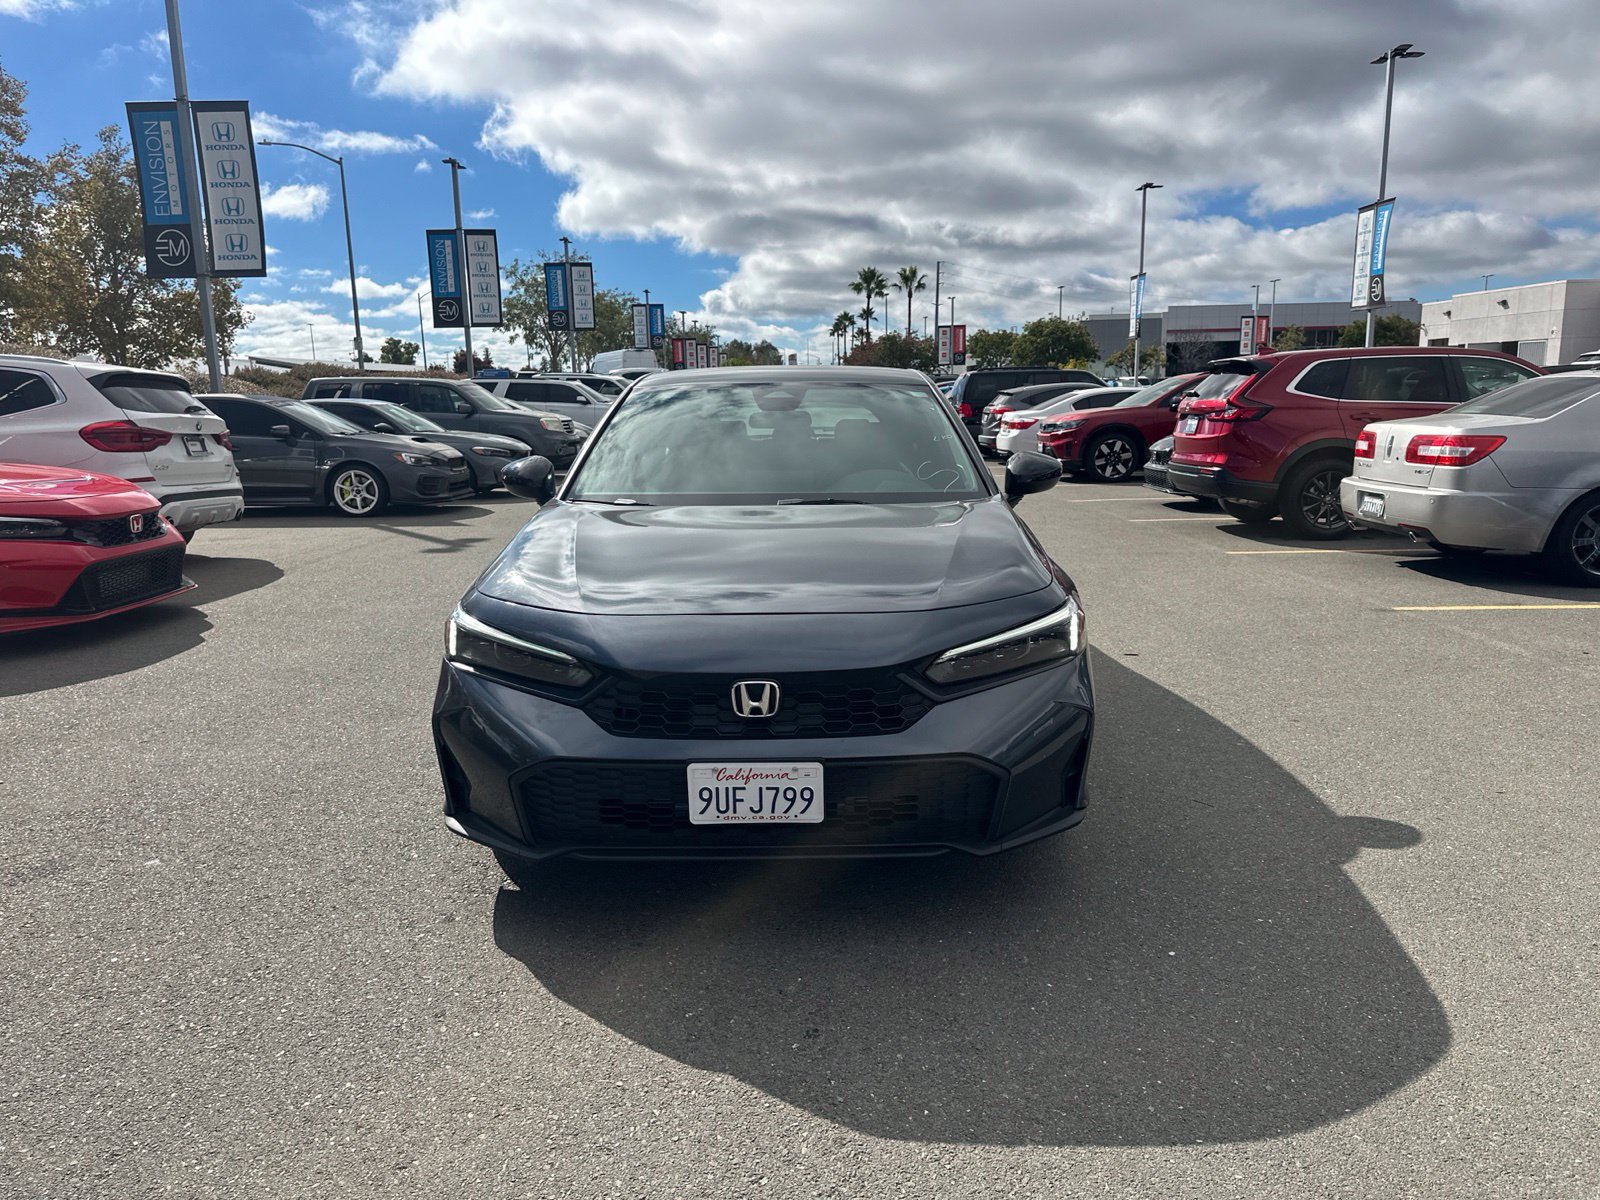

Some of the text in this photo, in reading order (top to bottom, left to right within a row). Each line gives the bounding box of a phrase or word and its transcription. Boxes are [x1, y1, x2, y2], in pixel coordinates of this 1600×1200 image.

[143, 121, 171, 216] ENVISION
[163, 129, 180, 208] MOTORS
[435, 239, 448, 293] ENVISION
[698, 786, 815, 815] 9UFJ799
[715, 767, 798, 785] California
